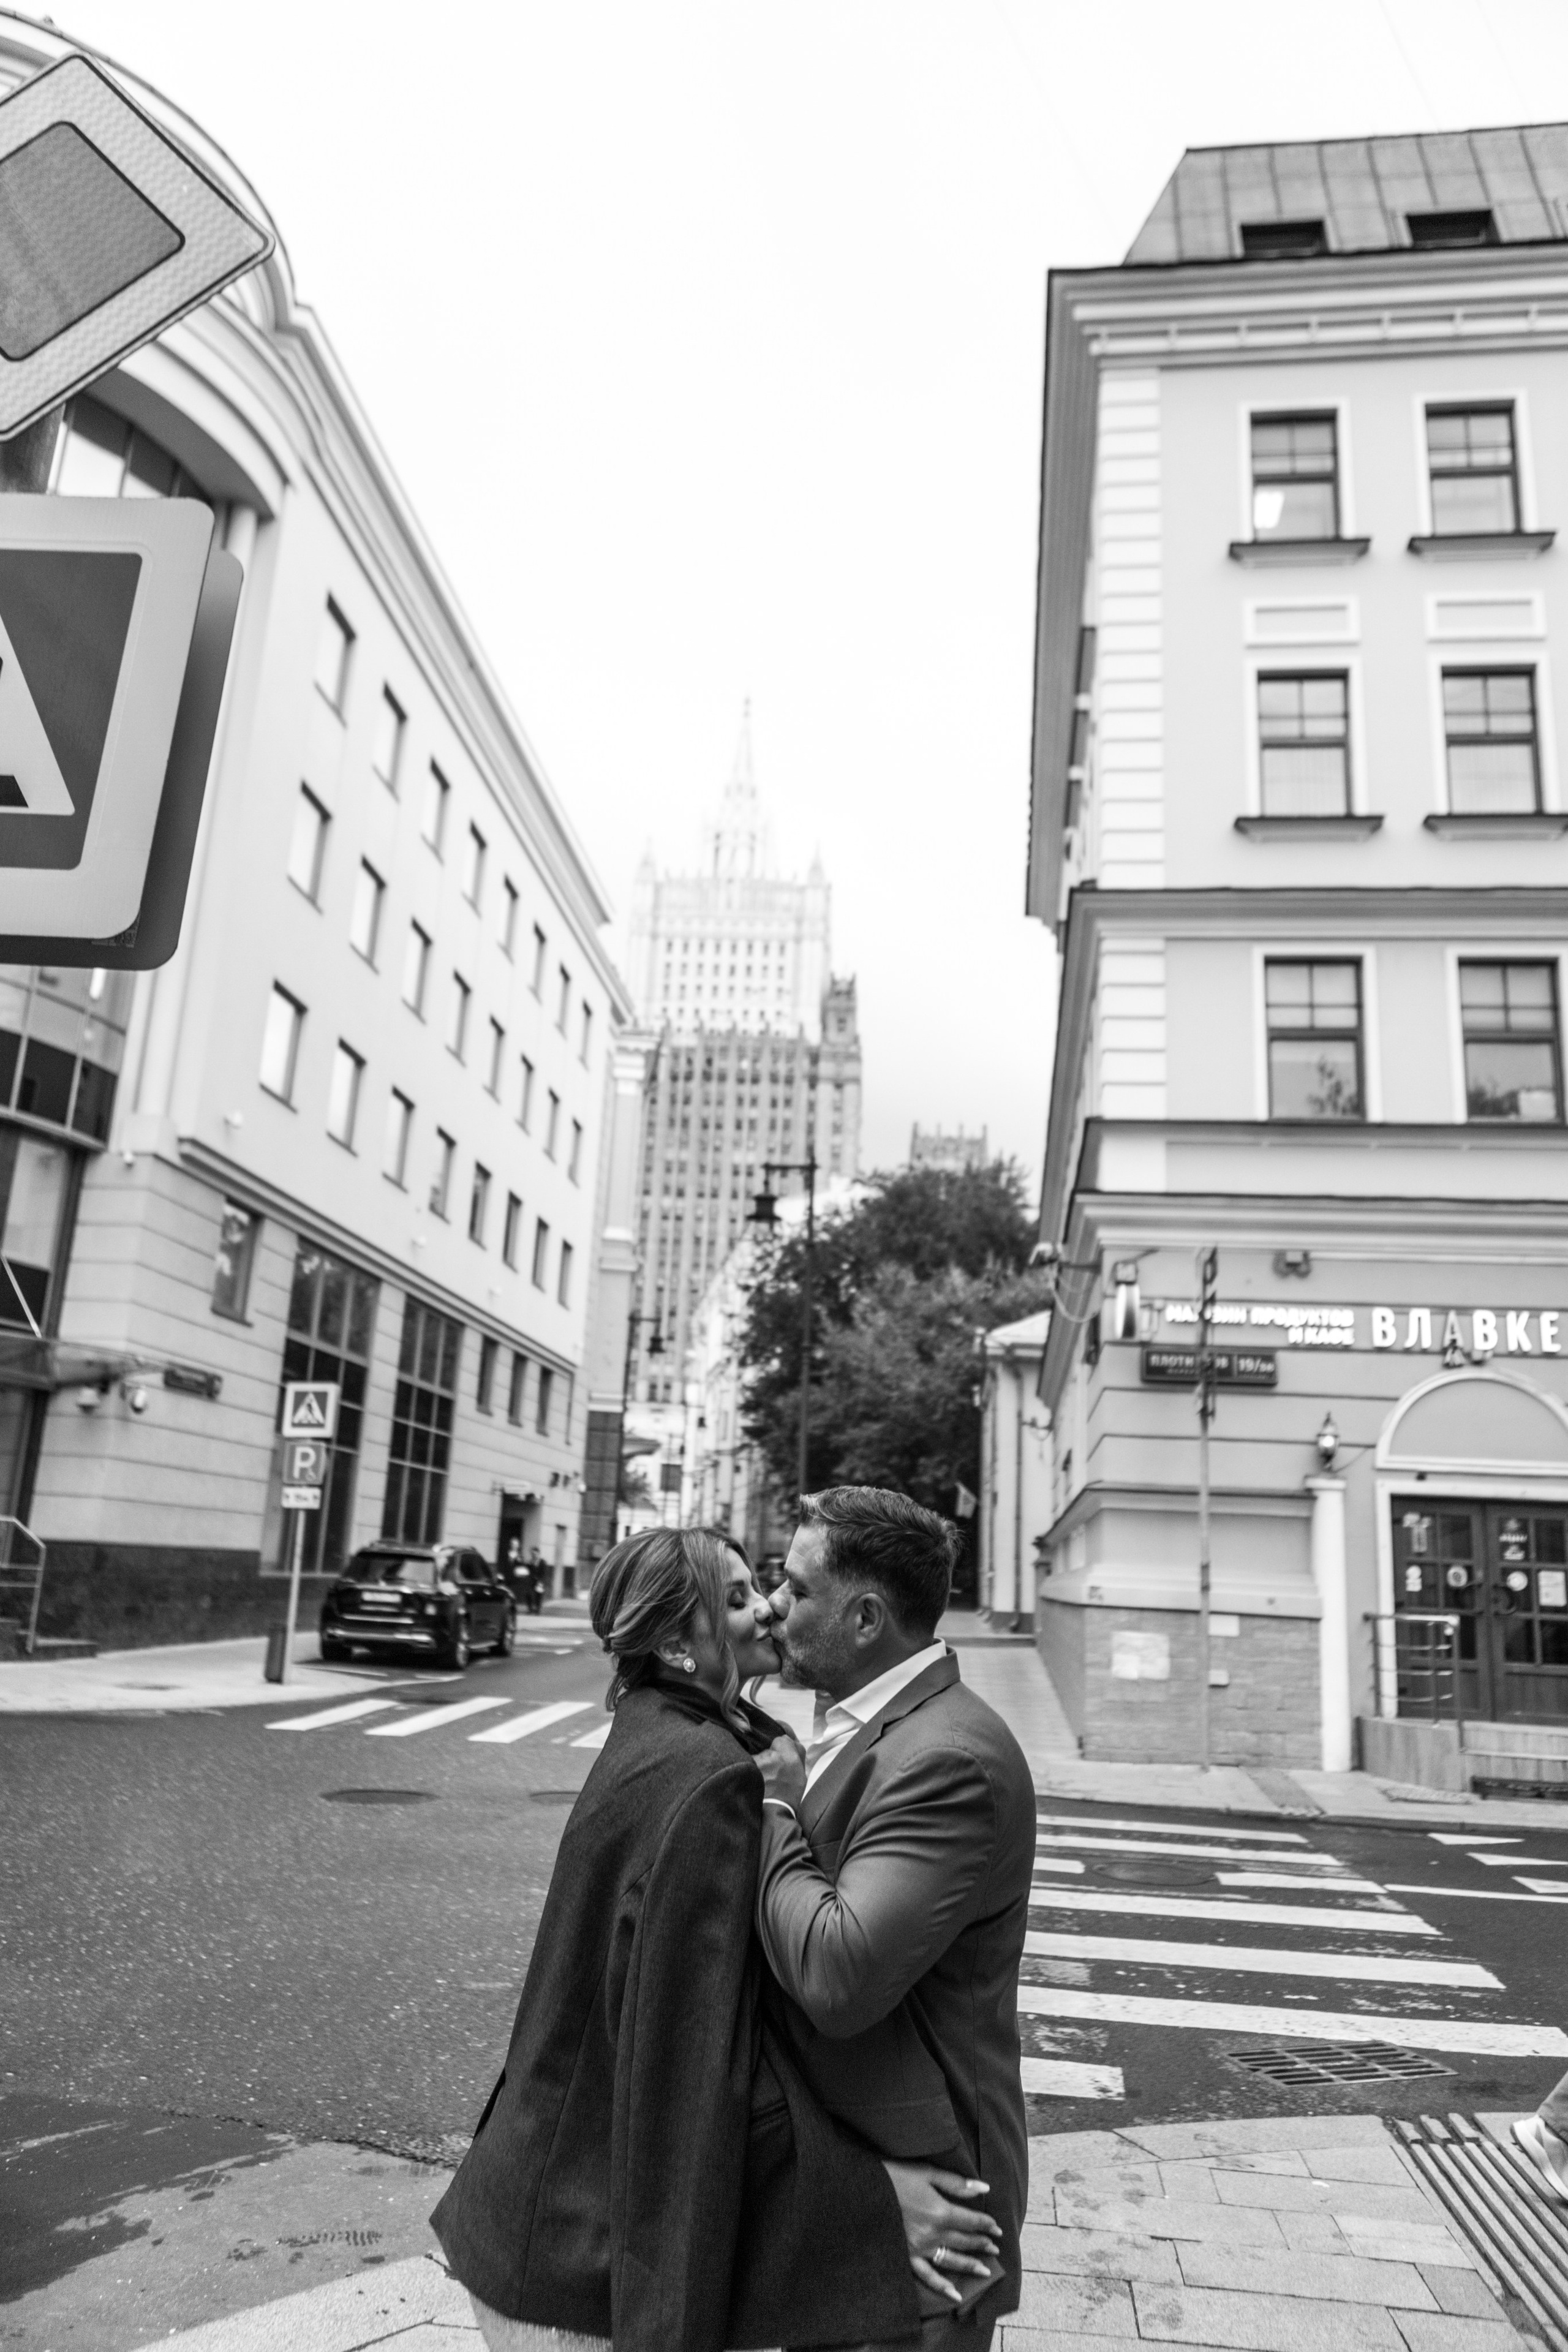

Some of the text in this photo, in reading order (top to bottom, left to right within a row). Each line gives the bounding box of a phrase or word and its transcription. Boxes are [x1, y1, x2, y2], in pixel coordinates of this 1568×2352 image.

[1165, 1304, 1354, 1329] МАЗИН ПРОДУКТОВ
[1287, 1327, 1355, 1346] И КАФЕ
[1150, 1354, 1229, 1369] ПЛОТНОВ
[293, 1446, 317, 1480] P
